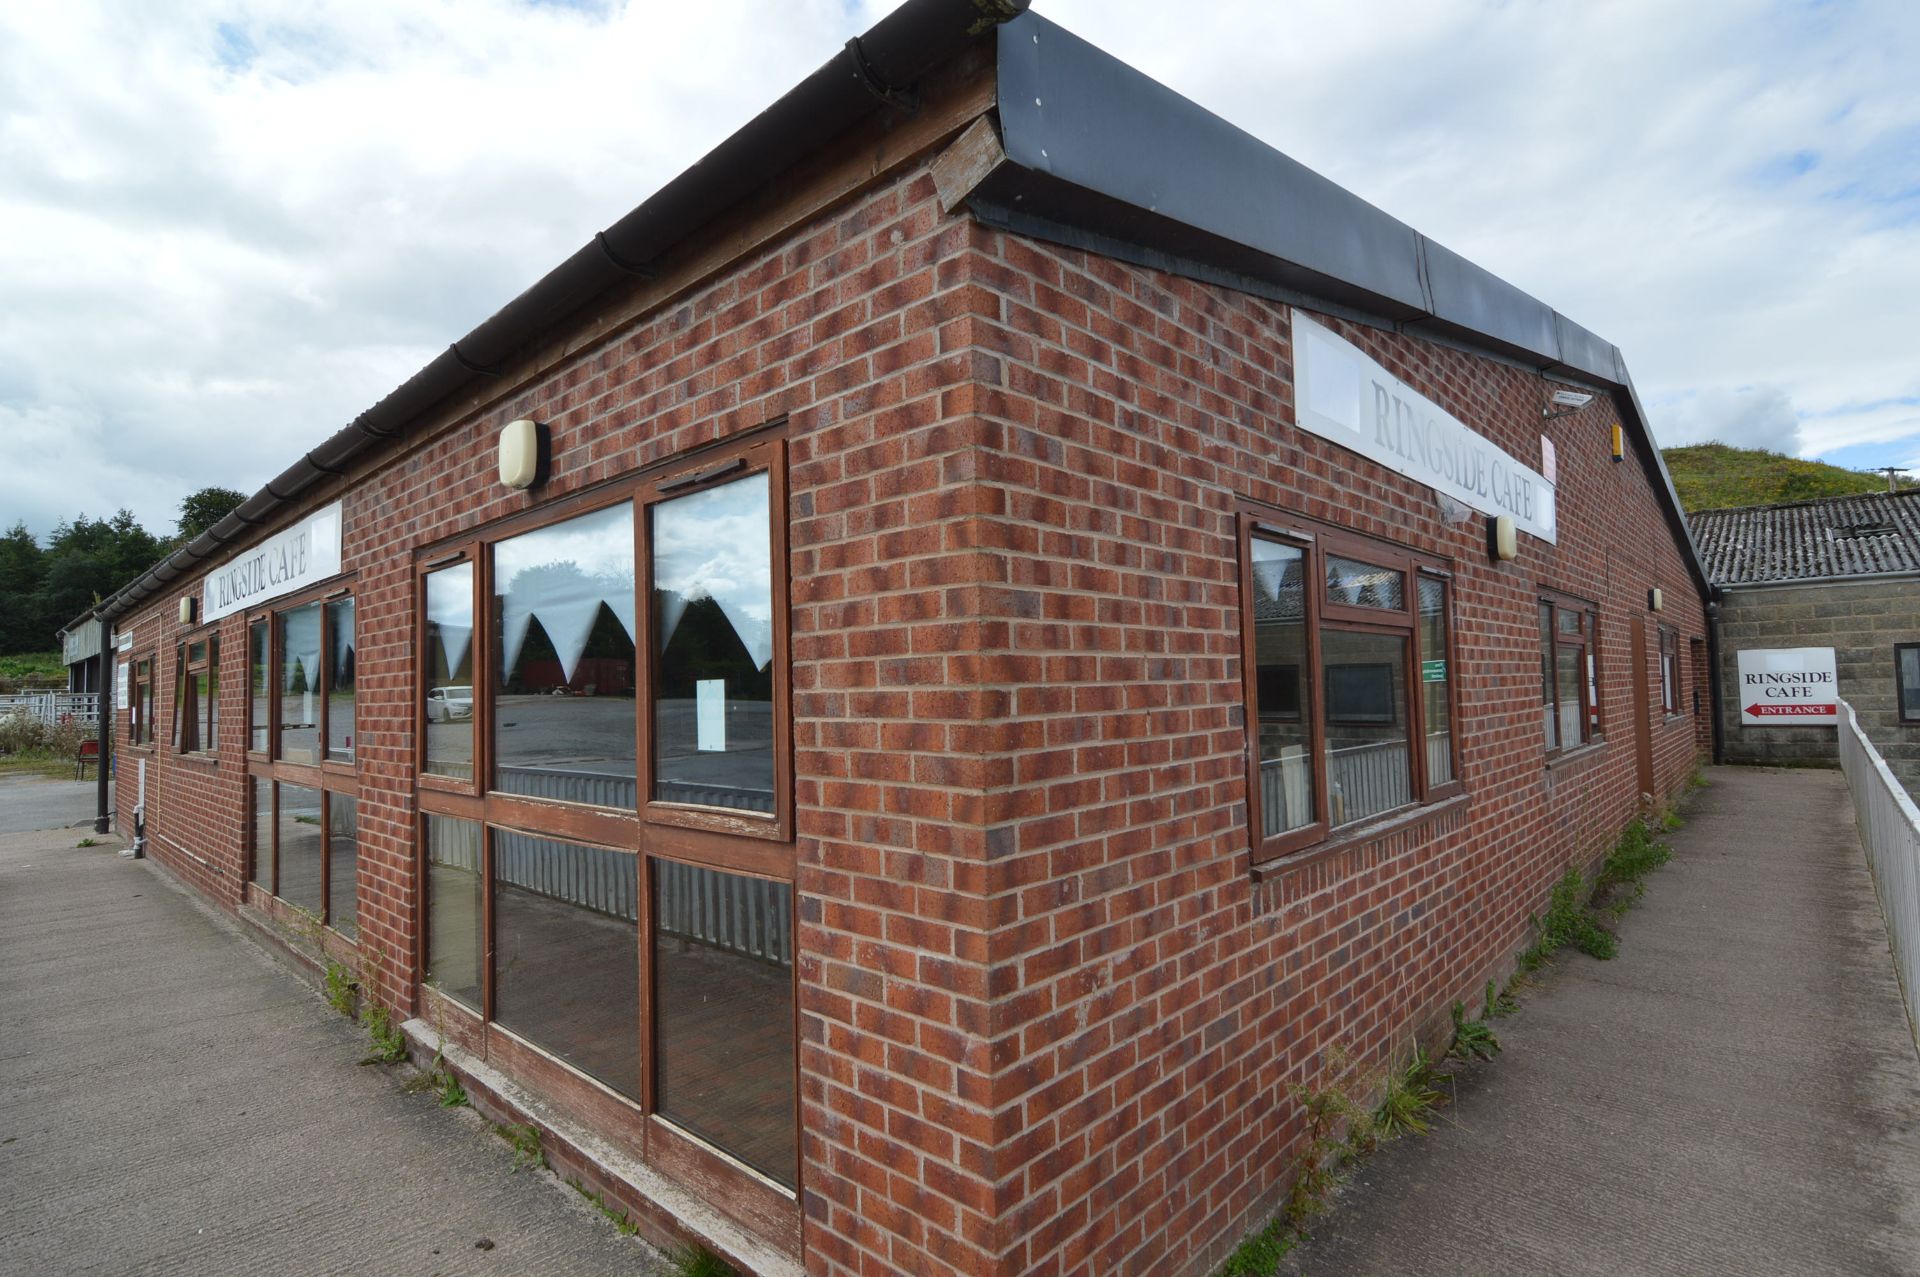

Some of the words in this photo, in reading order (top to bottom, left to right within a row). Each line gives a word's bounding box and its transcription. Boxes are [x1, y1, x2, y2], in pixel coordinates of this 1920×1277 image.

[1371, 378, 1488, 498] RINGSIDE
[1491, 459, 1533, 522] CAFE
[218, 553, 266, 609] RINGSIDE
[268, 532, 307, 587] CAFE
[1744, 672, 1832, 684] RINGSIDE
[1765, 687, 1813, 697] CAFE
[1760, 706, 1826, 714] ENTRANCE
